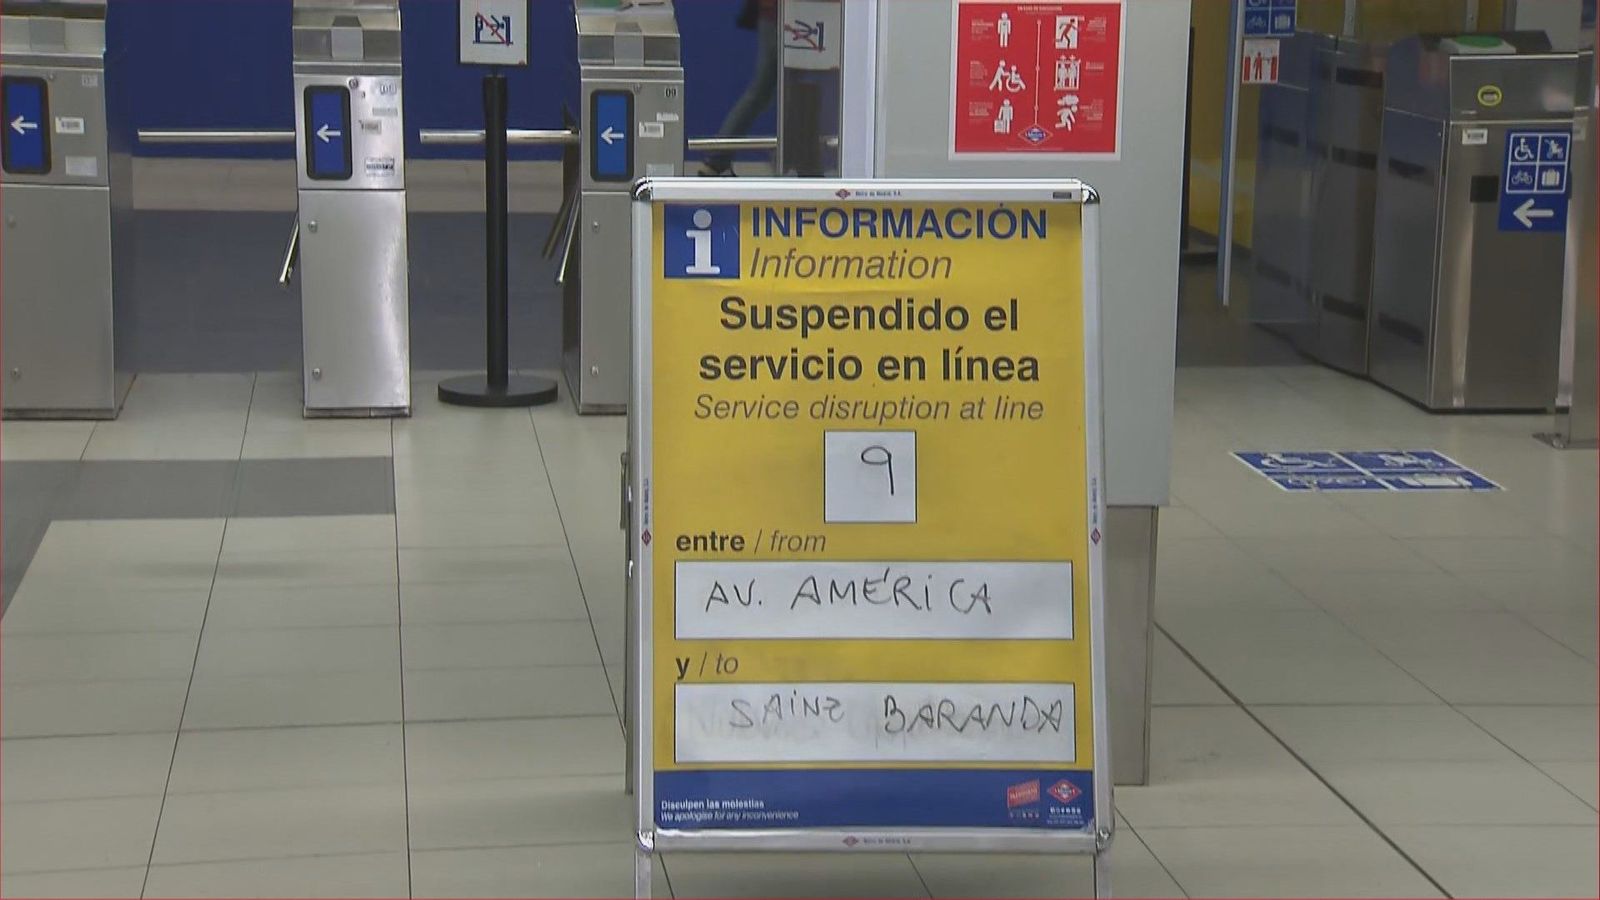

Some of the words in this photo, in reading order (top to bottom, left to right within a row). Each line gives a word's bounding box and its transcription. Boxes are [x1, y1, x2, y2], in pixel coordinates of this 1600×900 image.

[752, 203, 1047, 239] INFORMACIÓN
[750, 247, 952, 280] Information
[720, 296, 970, 340] Suspendido
[984, 298, 1018, 332] el
[699, 347, 863, 382] servicio
[877, 355, 926, 382] en
[942, 345, 1040, 382] línea
[694, 393, 800, 420] Service
[809, 394, 950, 426] disruption
[959, 396, 986, 420] at
[994, 395, 1044, 420] line
[860, 445, 895, 496] 9
[676, 531, 745, 552] entre
[753, 528, 763, 554] /
[770, 530, 826, 553] from
[705, 578, 762, 613] AV.
[675, 657, 690, 681] y
[699, 651, 708, 677] /
[715, 652, 739, 675] to
[883, 694, 1063, 733] BARANDA
[661, 799, 704, 810] Disculpen
[706, 798, 720, 810] las
[721, 798, 765, 810] molestias
[661, 811, 674, 821] We
[714, 811, 726, 821] for
[726, 812, 741, 822] any
[742, 810, 799, 821] inconvenience
